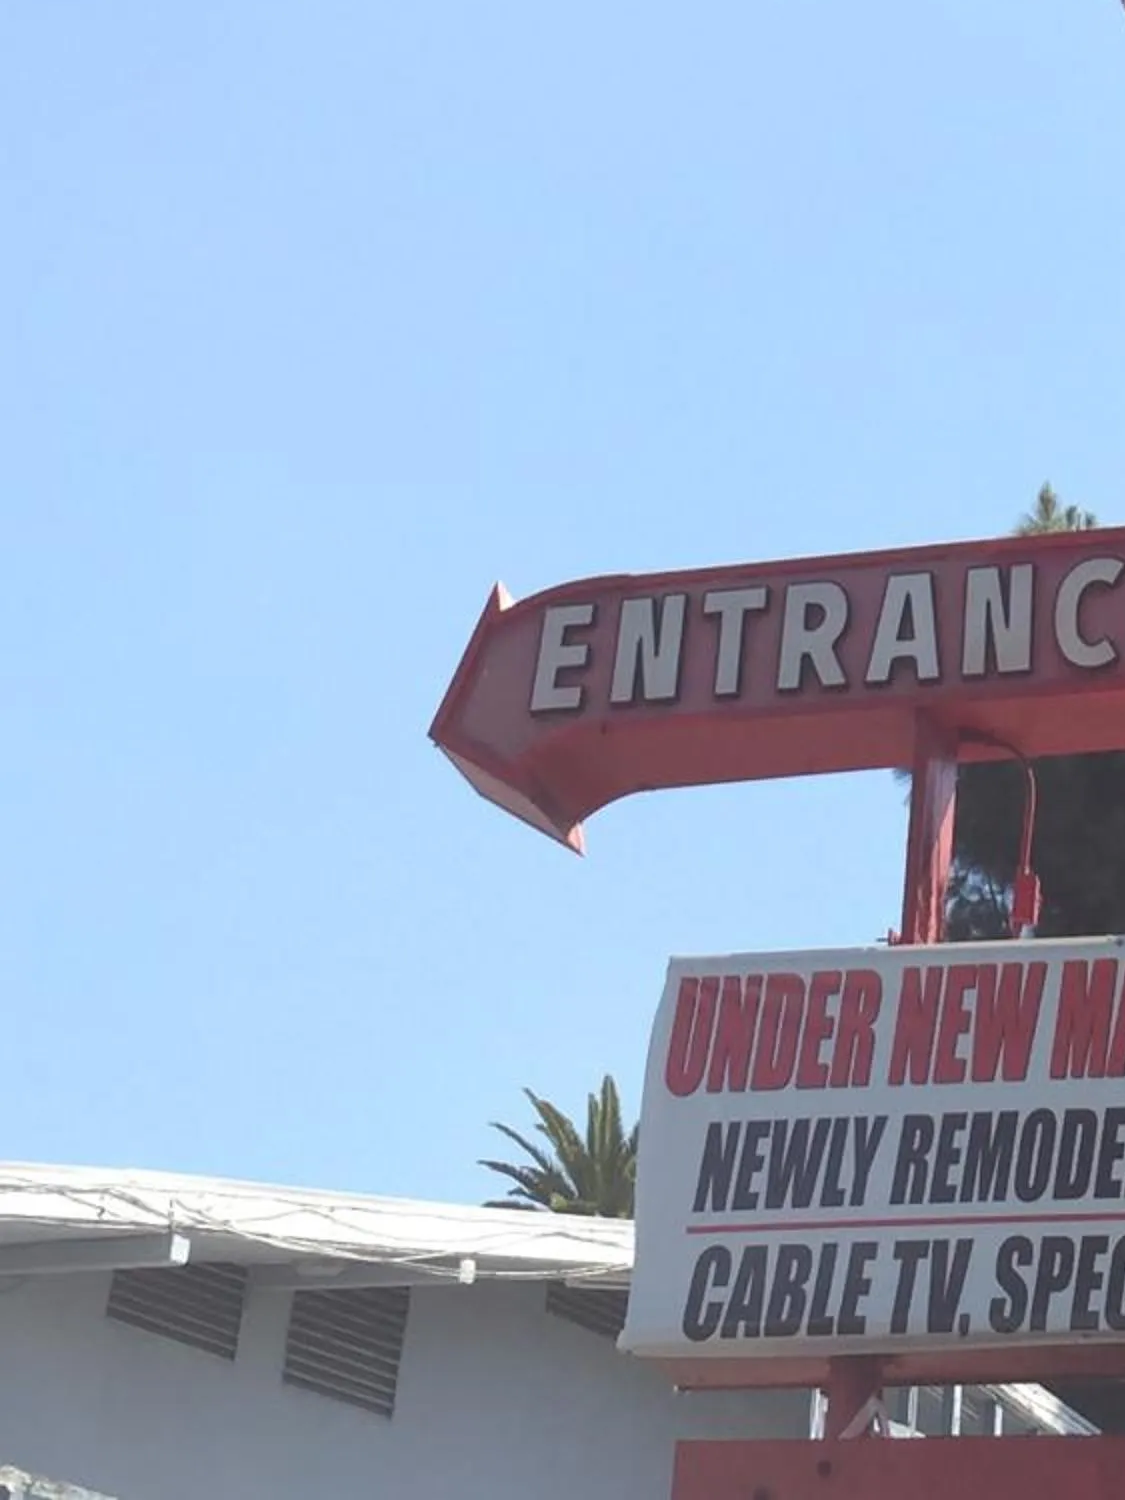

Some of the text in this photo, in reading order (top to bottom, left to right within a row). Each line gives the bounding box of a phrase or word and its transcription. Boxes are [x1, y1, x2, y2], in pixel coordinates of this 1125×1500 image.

[664, 968, 883, 1097] UNDER
[888, 961, 1049, 1087] NEW
[692, 1114, 886, 1213] NEWLY
[681, 1238, 879, 1342] CABLE
